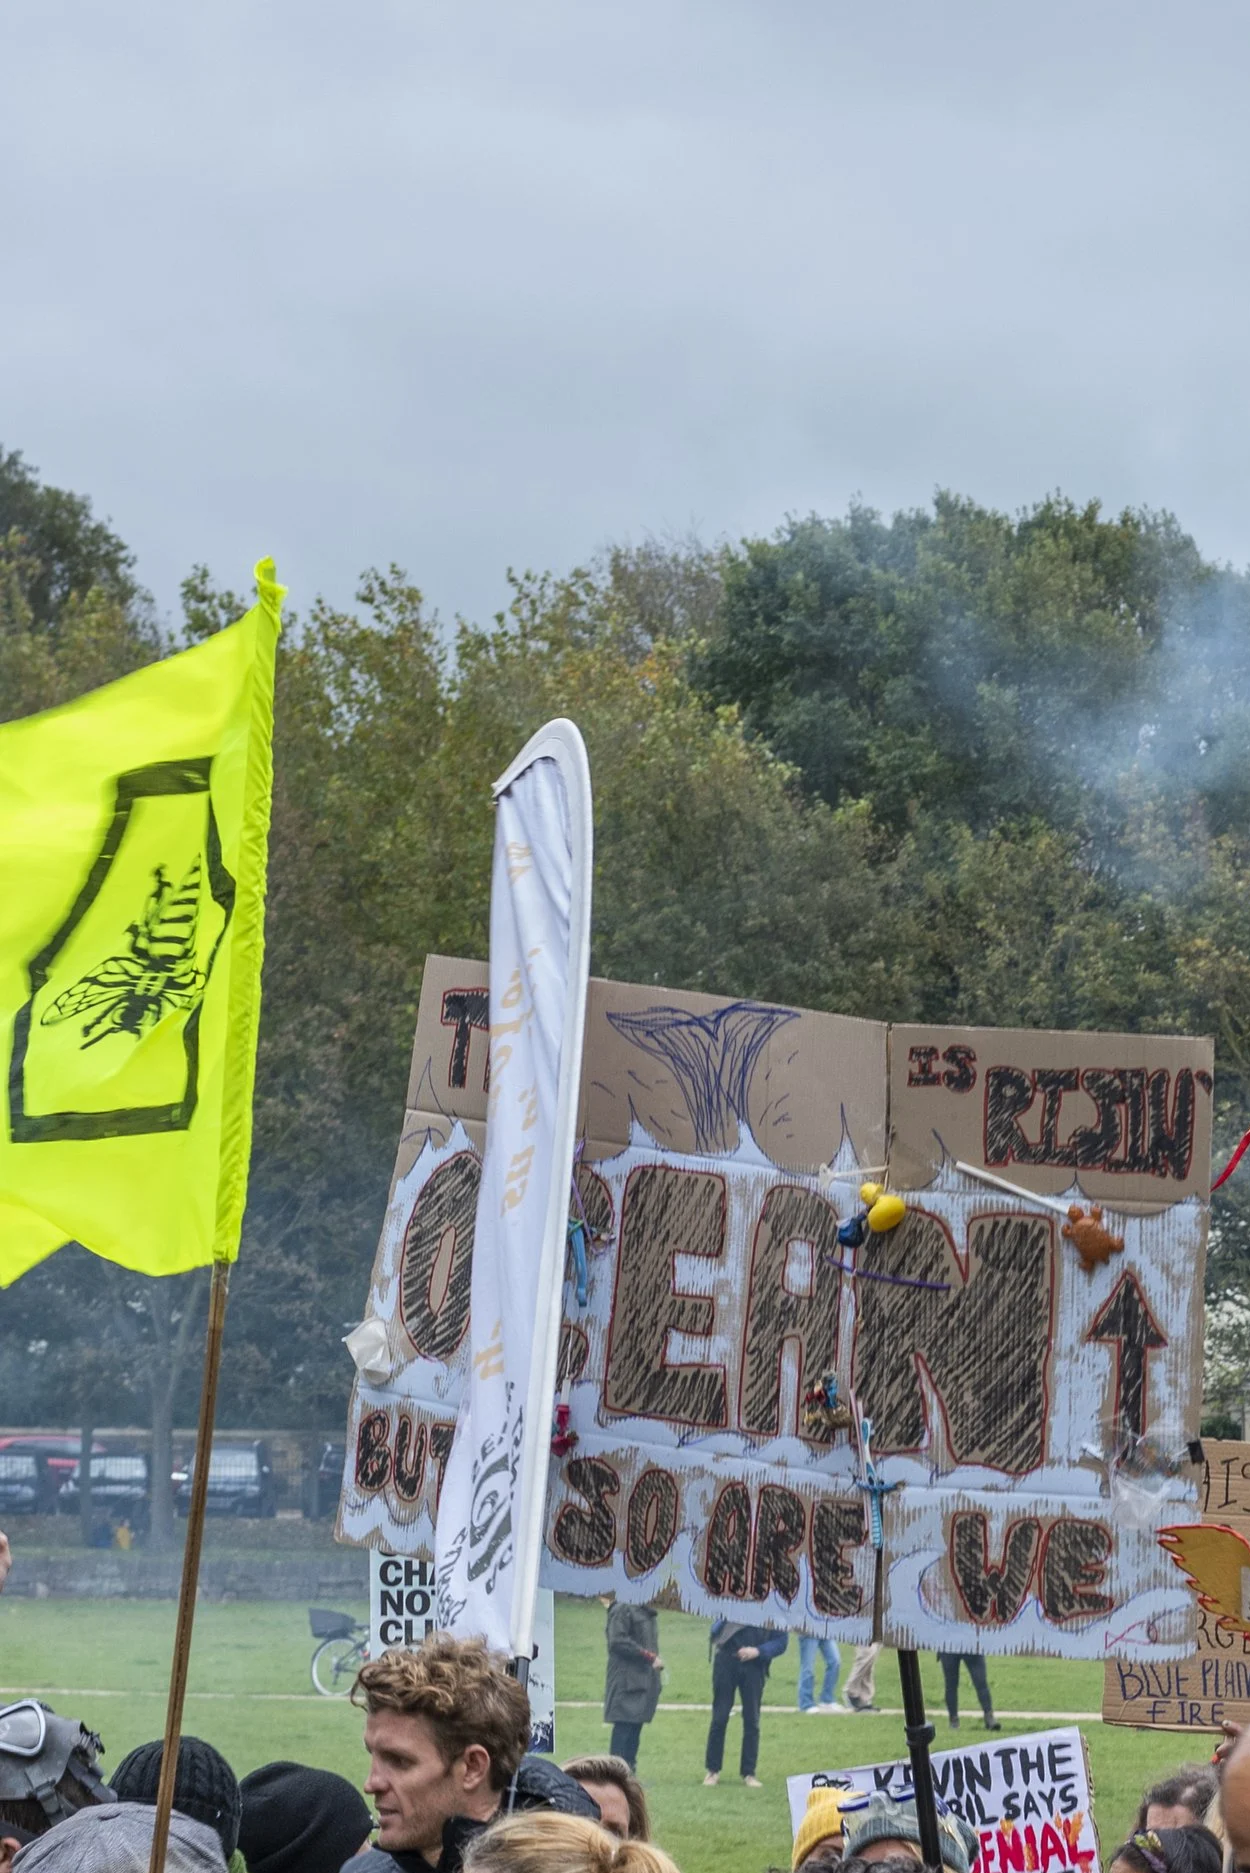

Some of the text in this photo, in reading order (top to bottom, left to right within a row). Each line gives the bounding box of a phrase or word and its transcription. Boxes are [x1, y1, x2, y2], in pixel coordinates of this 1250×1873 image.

[907, 1045, 977, 1093] IS
[399, 1148, 1057, 1478] OEAN
[551, 1456, 680, 1576] SO
[703, 1479, 870, 1617] ARE
[951, 1511, 1114, 1627] WE
[380, 1590, 434, 1616] NO
[1117, 1662, 1189, 1701] BLUE
[1147, 1701, 1225, 1726] FIRE
[873, 1743, 1078, 1798] KVIN THE
[1002, 1784, 1078, 1821] SAYS
